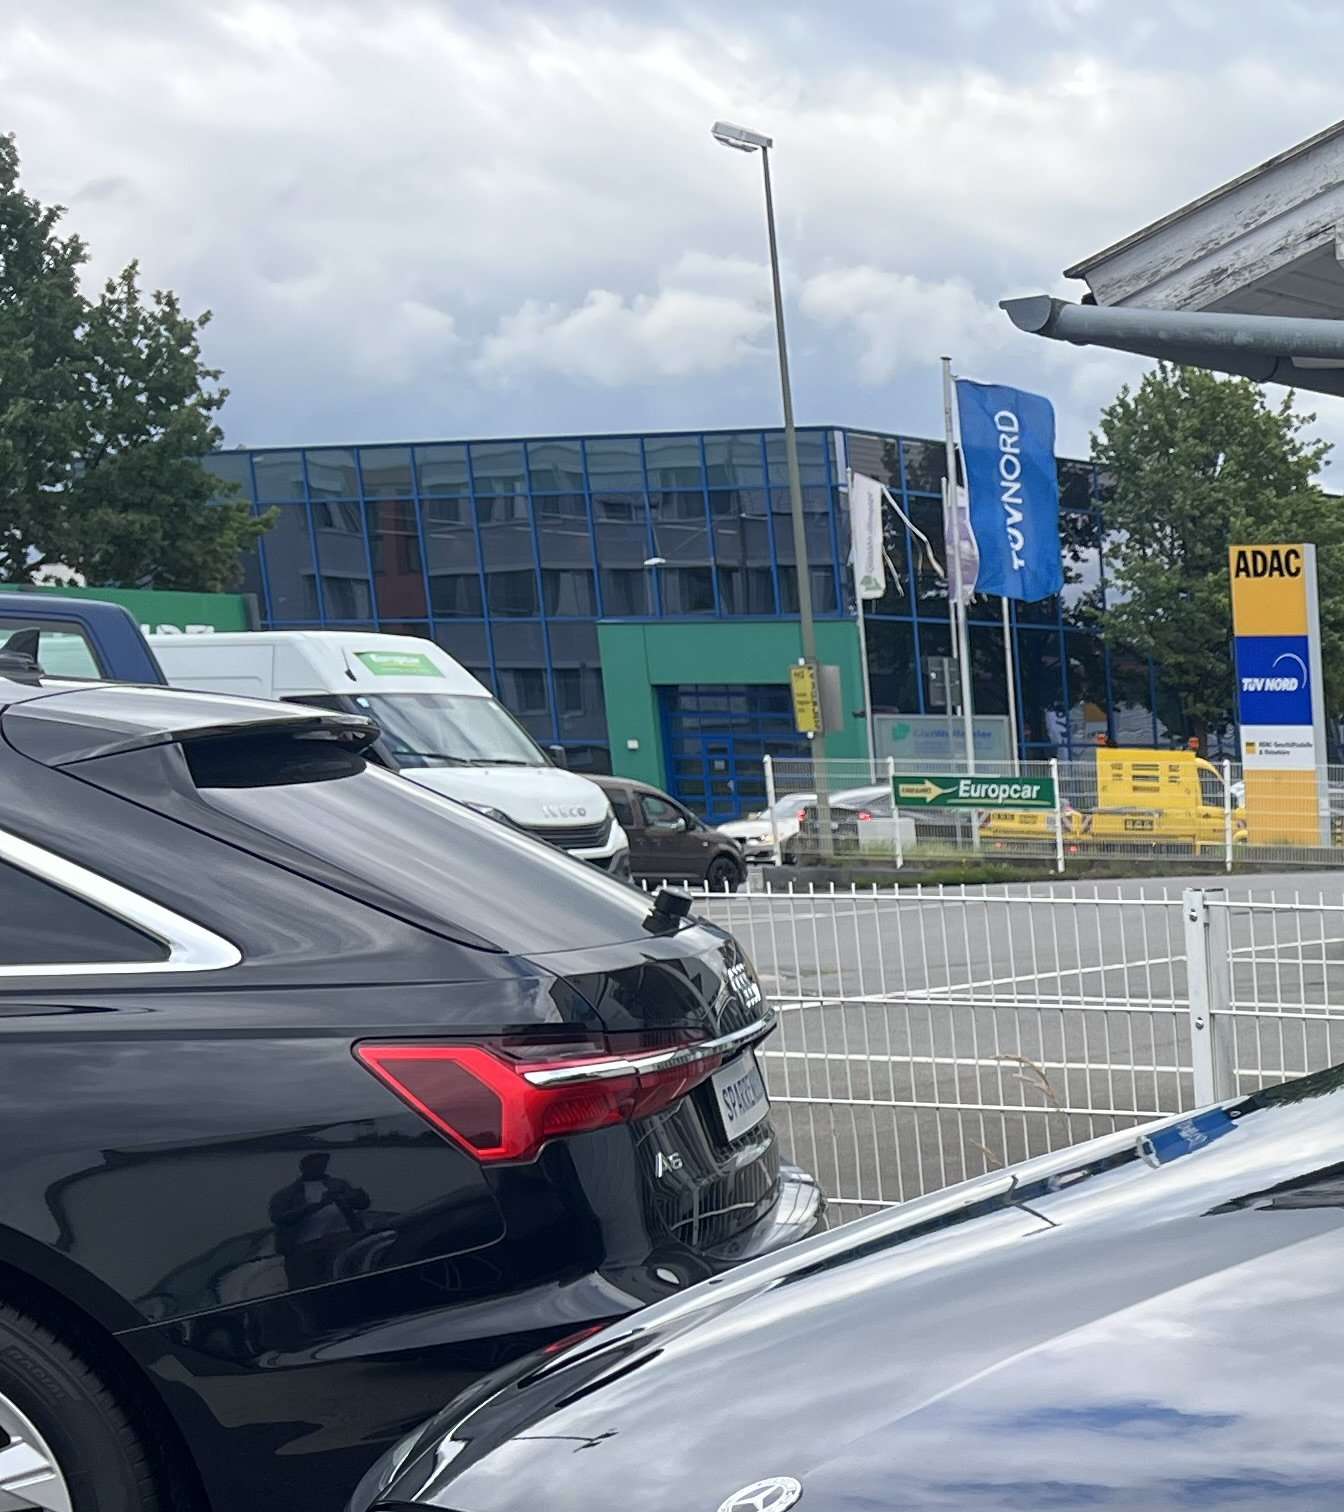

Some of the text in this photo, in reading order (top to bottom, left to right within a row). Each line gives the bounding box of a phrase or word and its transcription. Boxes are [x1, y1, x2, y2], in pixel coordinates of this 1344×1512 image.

[994, 410, 1023, 504] NORD
[1235, 549, 1301, 577] ADAC
[1264, 678, 1298, 691] NORD
[958, 779, 1040, 803] Europcar
[655, 1152, 683, 1178] A6
